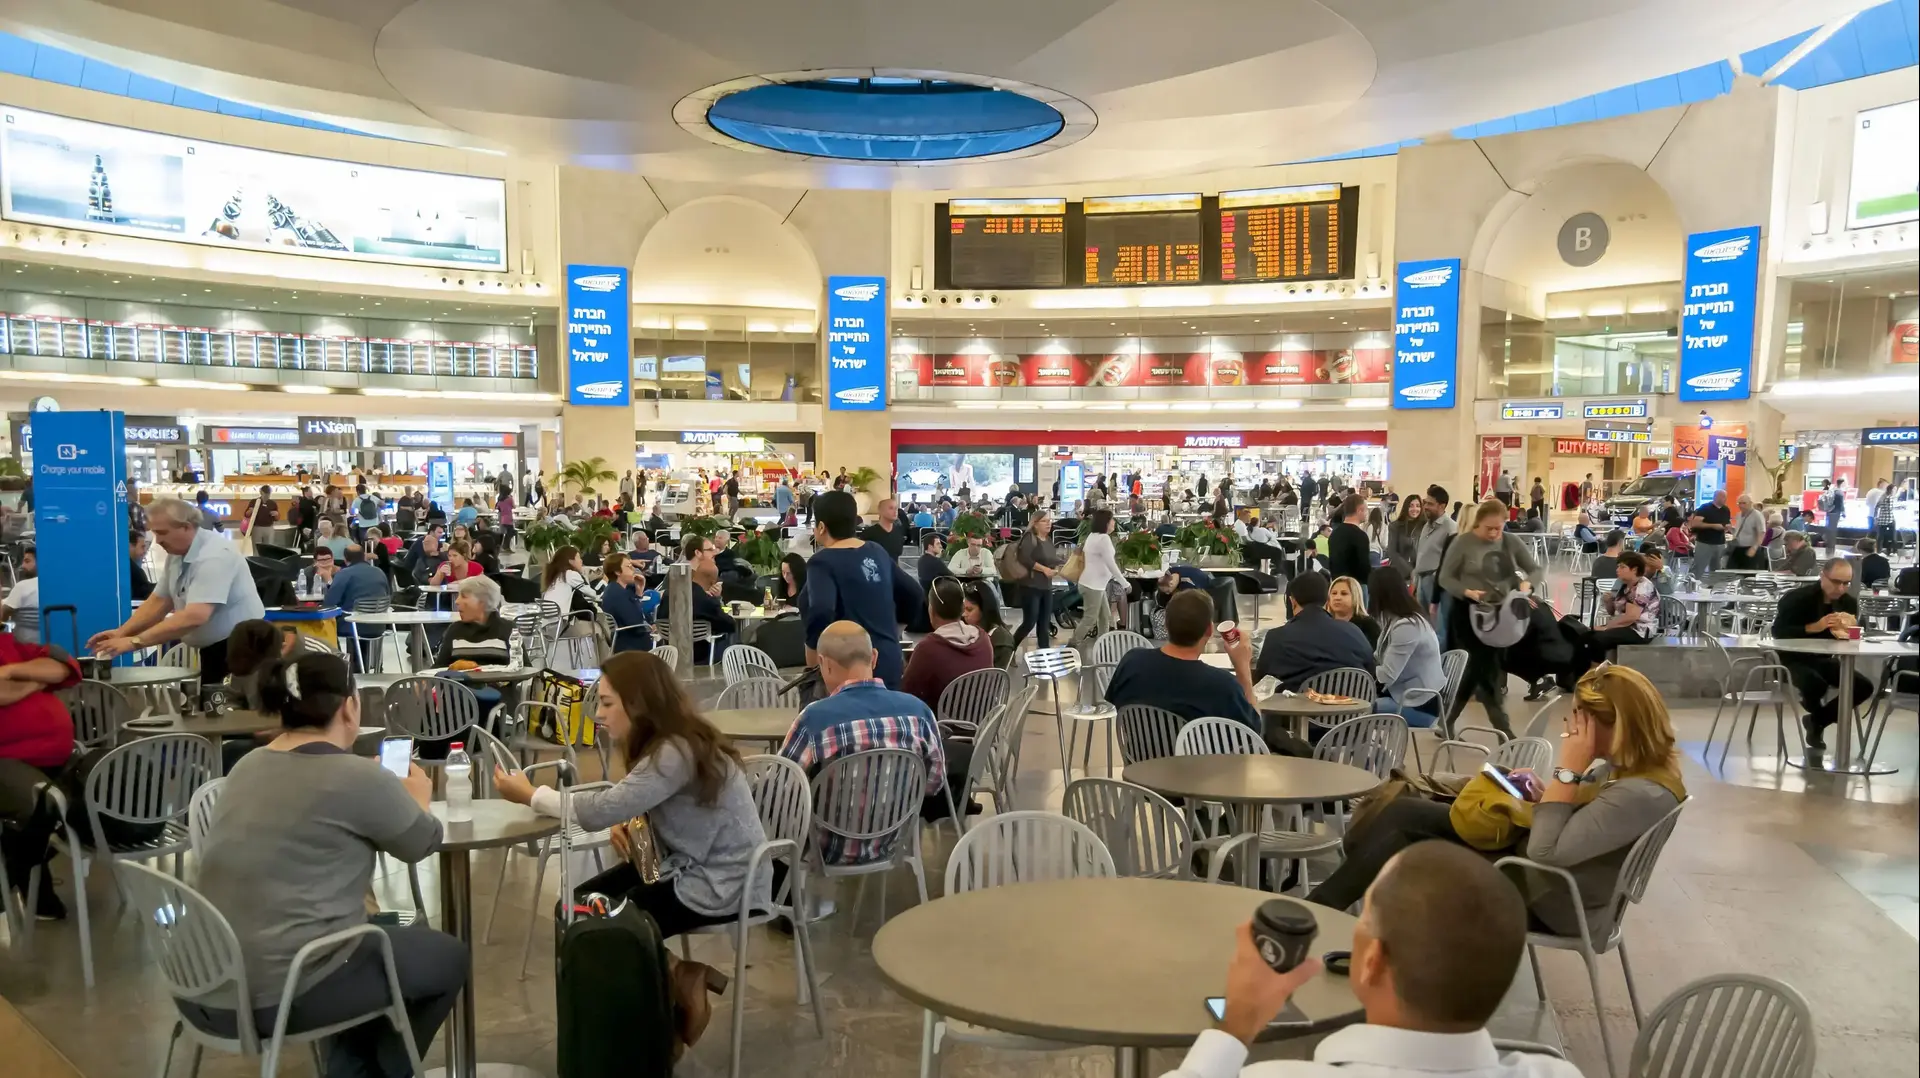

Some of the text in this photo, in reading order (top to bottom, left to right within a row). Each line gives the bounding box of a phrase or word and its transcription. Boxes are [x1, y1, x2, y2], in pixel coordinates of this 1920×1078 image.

[1575, 227, 1592, 251] B
[1690, 282, 1729, 298] חברת
[573, 307, 606, 320] חברת
[1401, 305, 1435, 318] חברת
[1683, 300, 1735, 316] התיירות
[833, 317, 865, 328] חברת
[1396, 322, 1440, 335] התיירות
[1699, 319, 1716, 330] של
[569, 323, 612, 335] התיירות
[583, 337, 597, 347] של
[829, 331, 870, 343] התיירות
[1409, 337, 1424, 347] של
[1685, 334, 1728, 349] ישראל
[572, 349, 609, 363] ישראל
[842, 345, 856, 355] של
[1397, 350, 1436, 363] ישראל
[832, 357, 867, 369] ישראל
[1219, 436, 1241, 447] FREE
[1557, 440, 1610, 455] DUTY FREE
[40, 464, 106, 476] Charge your mobile
